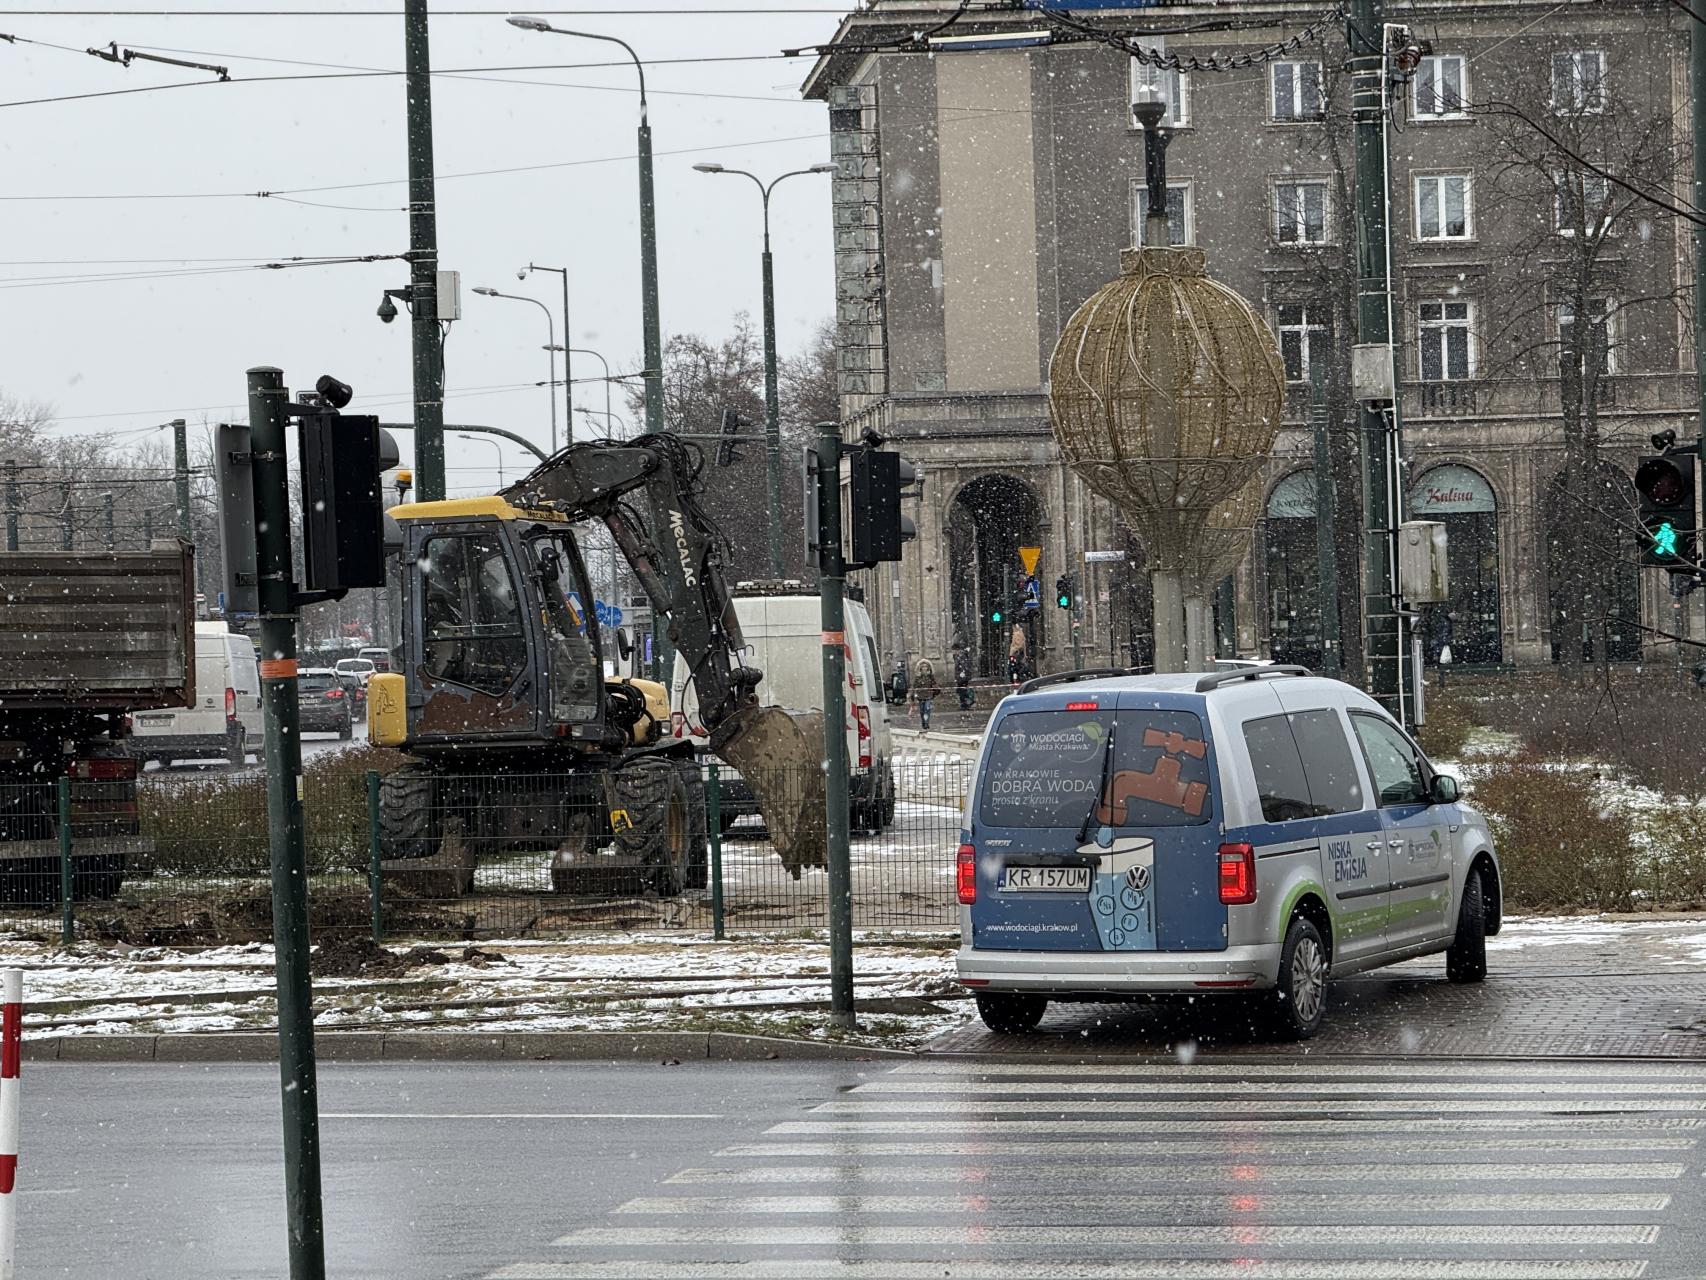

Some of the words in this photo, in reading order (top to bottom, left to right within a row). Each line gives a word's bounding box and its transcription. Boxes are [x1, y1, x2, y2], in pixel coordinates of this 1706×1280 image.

[1425, 487, 1473, 504] Kalina
[1030, 733, 1085, 744] WODOCIĄGI
[1029, 743, 1053, 751] Miasta
[1005, 769, 1060, 778] KRAKOWIE
[992, 780, 1042, 793] DOBRA
[1047, 779, 1095, 792] WODA
[992, 797, 1021, 807] prosto
[1029, 795, 1059, 805] kranu
[1327, 840, 1352, 860] NISKA
[1335, 857, 1368, 882] EMISJA
[1008, 869, 1031, 887] KR
[1039, 869, 1088, 887] 157UM
[986, 923, 1078, 933] www.wodociagi.krakow.pl
